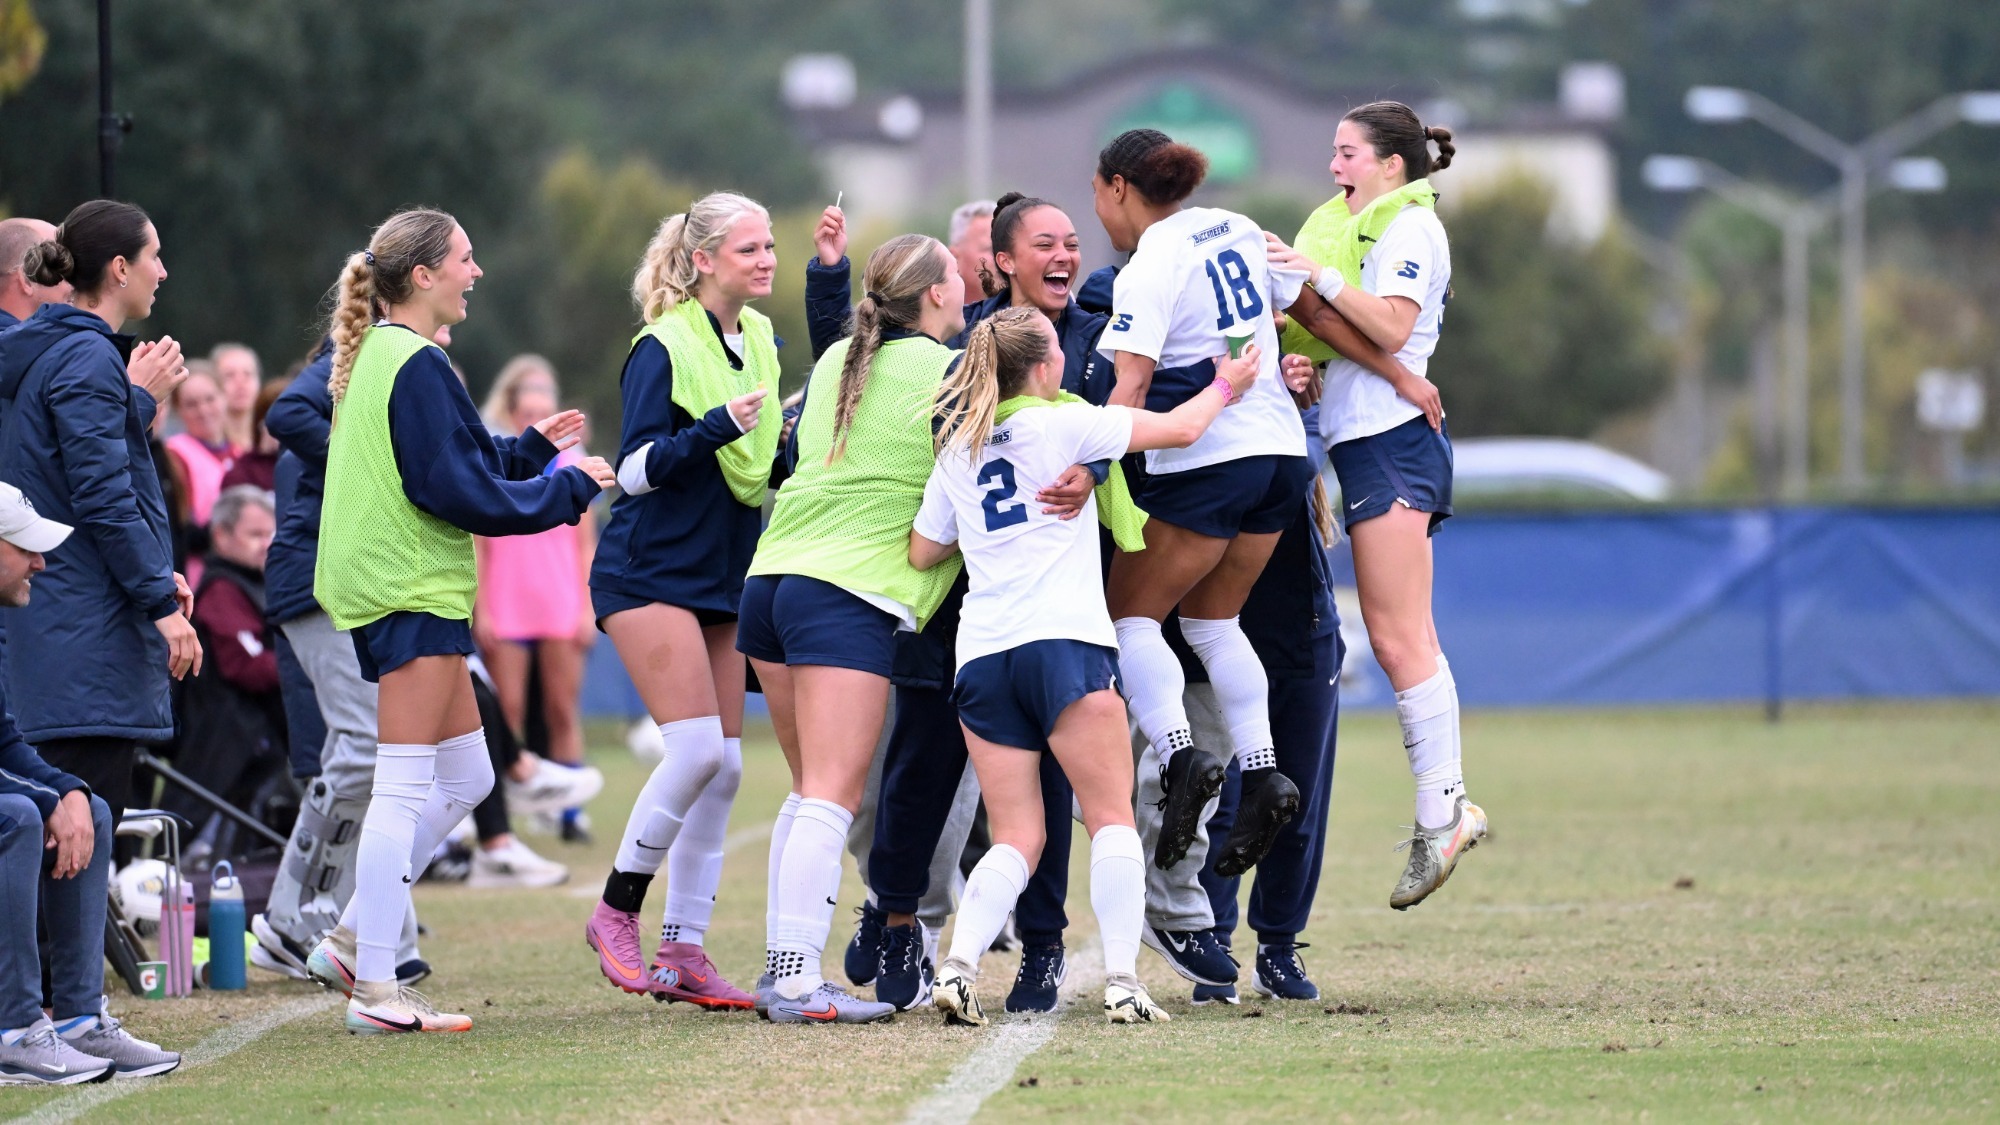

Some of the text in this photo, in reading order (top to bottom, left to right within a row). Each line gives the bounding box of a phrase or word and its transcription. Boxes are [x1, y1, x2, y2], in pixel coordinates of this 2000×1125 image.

[1205, 249, 1263, 331] 18
[977, 457, 1028, 532] 2
[140, 969, 157, 991] G
